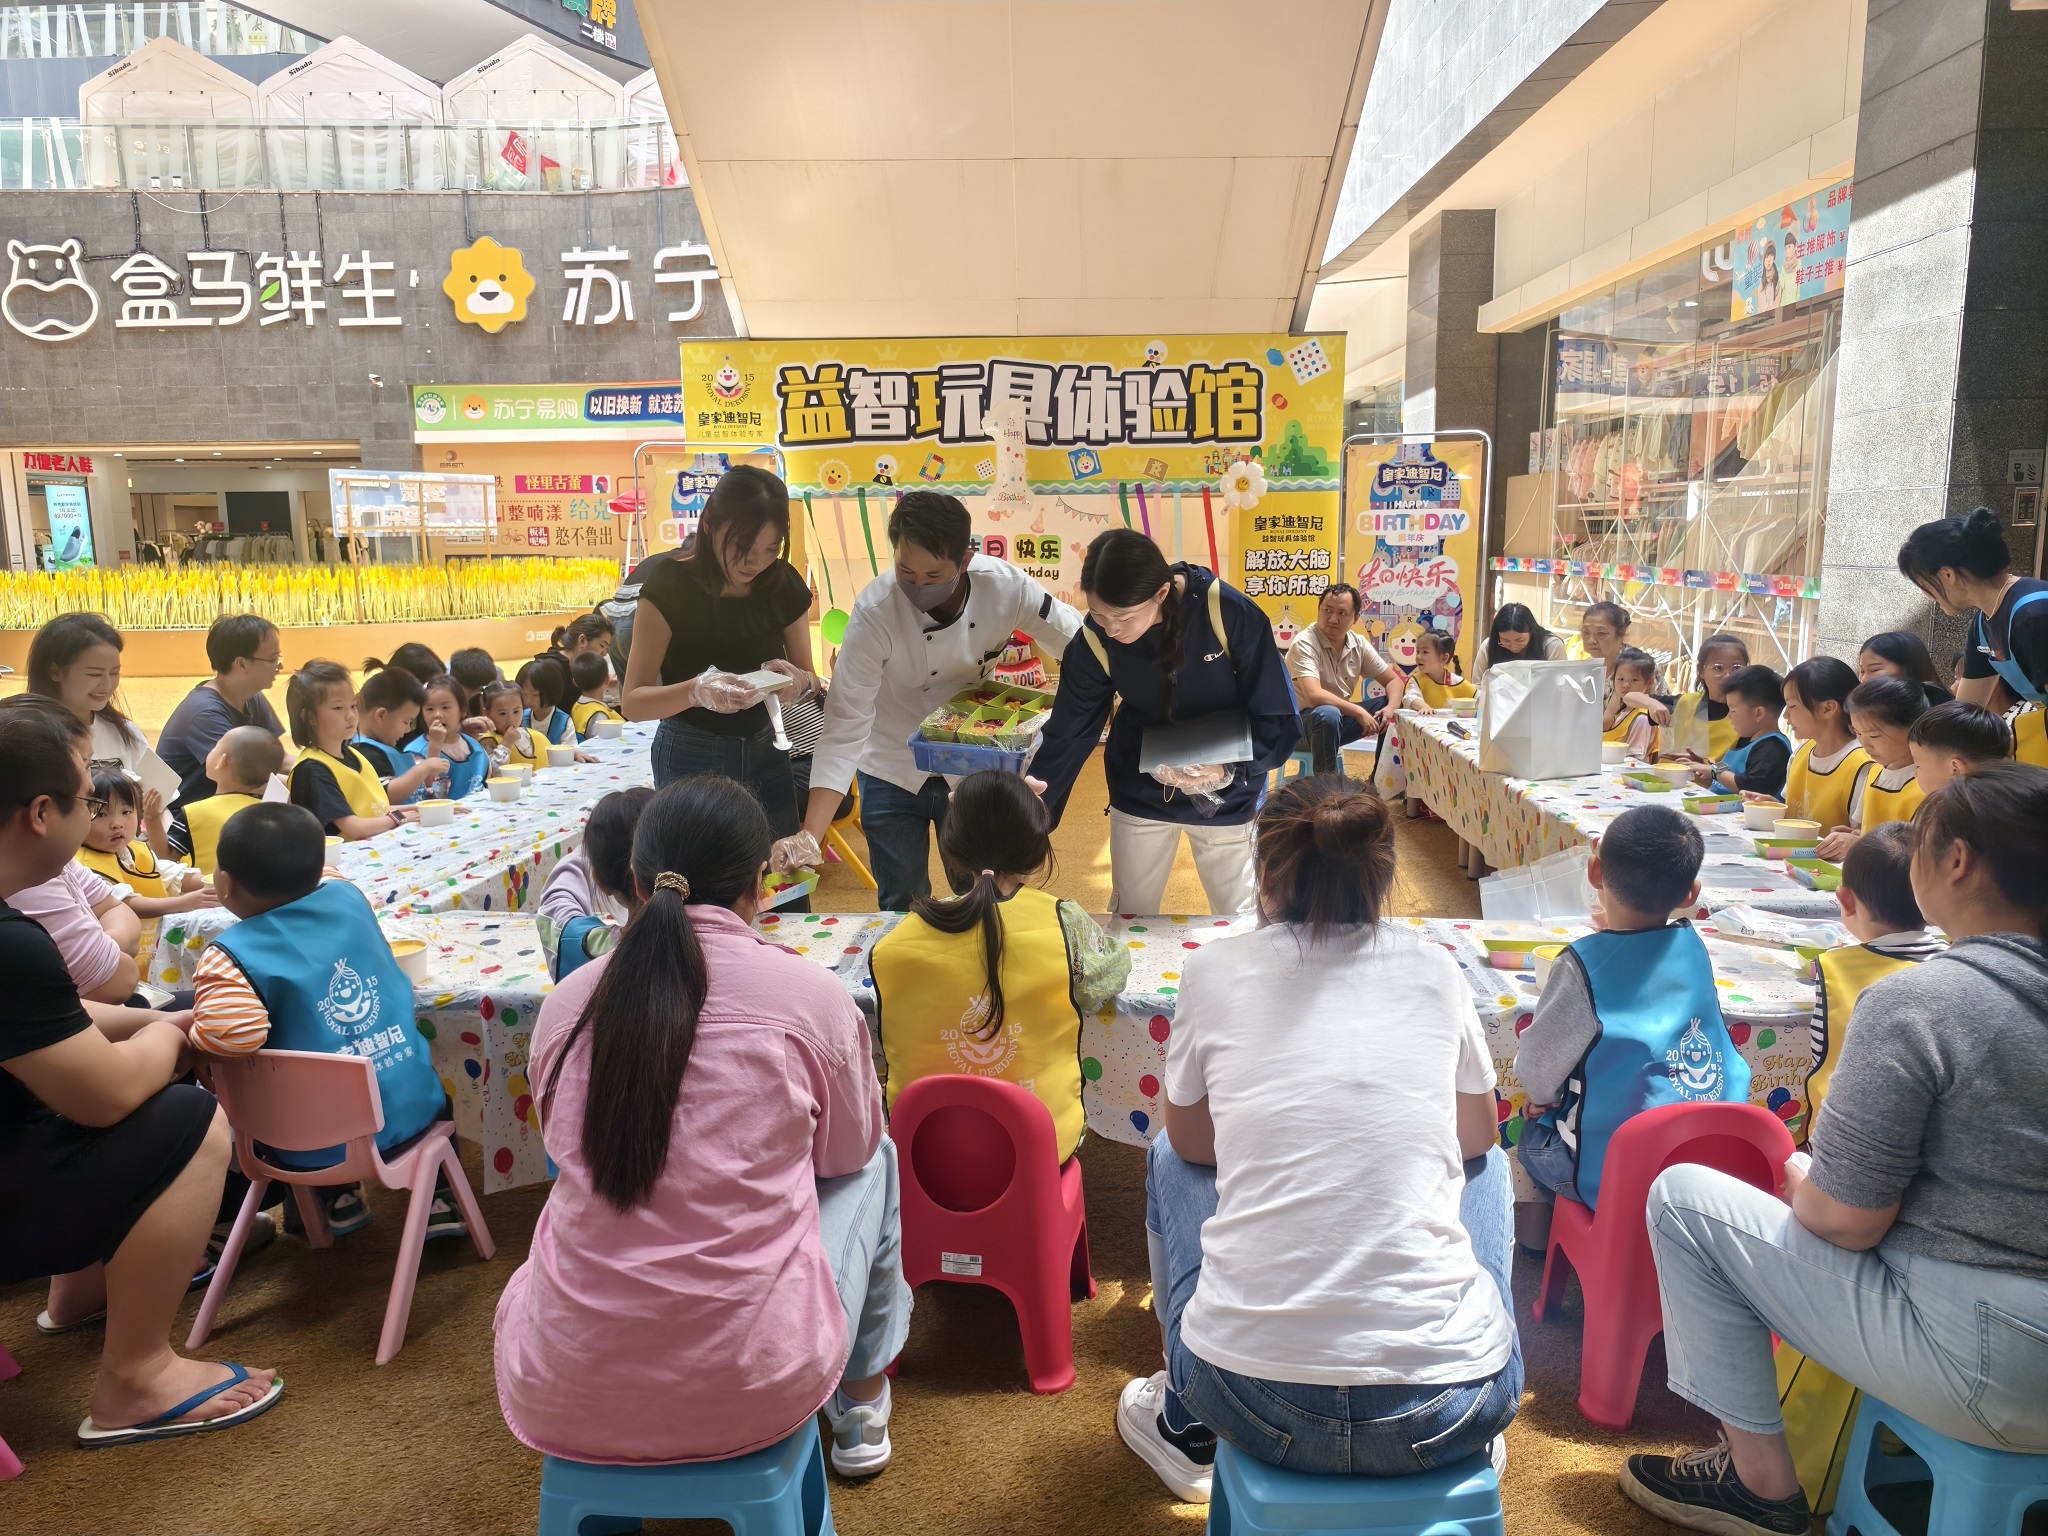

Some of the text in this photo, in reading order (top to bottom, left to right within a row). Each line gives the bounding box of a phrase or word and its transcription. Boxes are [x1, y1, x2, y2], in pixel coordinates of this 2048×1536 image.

[108, 61, 132, 78] Sibada
[288, 59, 313, 77] Sibada
[477, 58, 501, 74] Sibada
[1796, 230, 1837, 260] 主推服饰
[1795, 259, 1834, 285] 鞋子主推
[110, 250, 403, 328] 盒马鲜生
[560, 240, 719, 325] 苏宁
[701, 373, 755, 382] 20 15
[705, 382, 752, 408] ROYAL DEEDSNY
[779, 361, 1261, 444] 益智玩具体验馆
[493, 398, 579, 420] 苏宁易购
[589, 395, 642, 416] 以旧换新
[698, 410, 762, 427] 皇家迪智尼
[698, 430, 764, 438] 儿童益智体验专家
[1003, 428, 1024, 442] Happy
[23, 452, 94, 474] 力健老人鞋
[525, 474, 582, 491] 怪里古董
[682, 475, 721, 491] 皇家迪
[1382, 466, 1443, 483] 皇家迪智尼
[997, 491, 1027, 505] Birthday
[1394, 500, 1430, 509] HAPPY
[508, 504, 562, 522] 整喃漾
[1359, 513, 1466, 532] BIRTHDAY
[529, 527, 548, 537] 板扎
[1254, 514, 1323, 532] 皇家迪智尼
[555, 525, 613, 547] 憨不鲁出
[1262, 535, 1316, 543] 益智玩具体验馆
[1398, 533, 1424, 543] 周年庆
[1016, 538, 1060, 560] 快乐
[1245, 549, 1331, 572] 解放大脑
[1024, 566, 1060, 581] hday
[1356, 556, 1460, 596] 生日快乐
[1244, 574, 1330, 597] 享你所想
[1371, 588, 1436, 600] Happy Birthday
[317, 975, 378, 1012] 20 15
[323, 988, 381, 1036] ROYAL DEEDSNY
[940, 1022, 1023, 1041] 20 15
[946, 1036, 1018, 1077] ROYAL DEEDSNY
[1666, 1049, 1679, 1062] 20
[1763, 1053, 1815, 1072] Happ
[1668, 1062, 1725, 1102] ROYAL DEEDSNY
[1750, 1068, 1807, 1093] Birth
